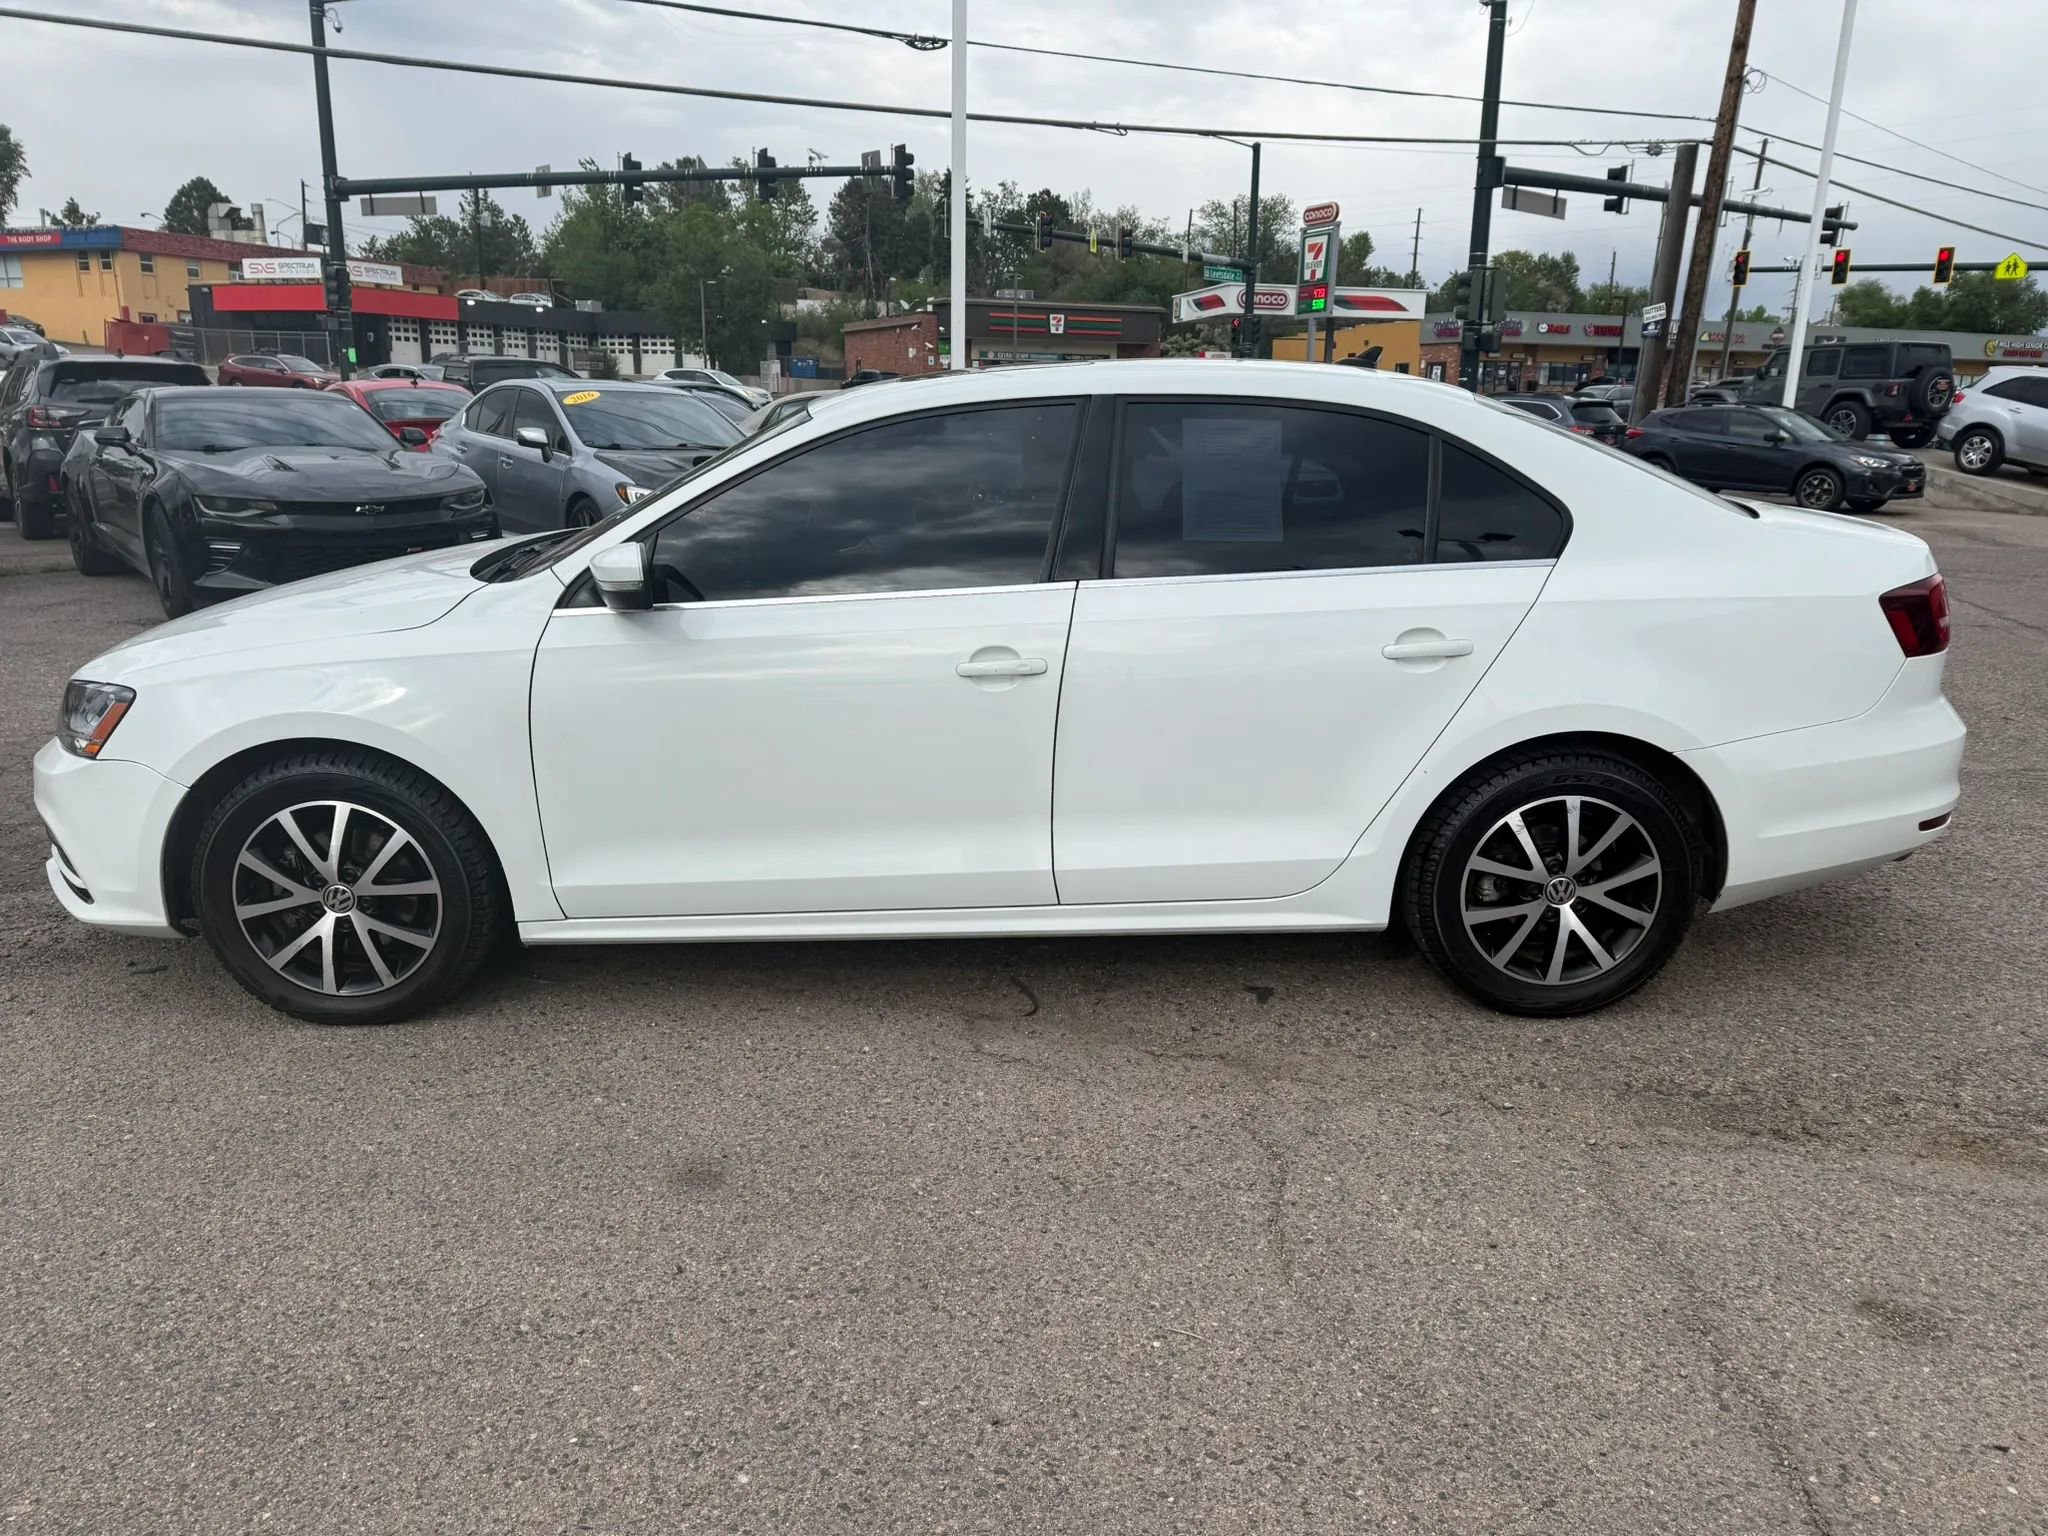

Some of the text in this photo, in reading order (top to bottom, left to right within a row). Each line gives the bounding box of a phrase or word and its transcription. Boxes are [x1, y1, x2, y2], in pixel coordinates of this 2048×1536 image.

[6, 234, 52, 243] THE BODY SHOP
[278, 261, 315, 269] SPECTRUM
[364, 267, 397, 276] SPECTRUM
[1210, 269, 1235, 281] Leetsdale
[1644, 304, 1665, 316] GUTTERS
[570, 392, 595, 403] 2016
